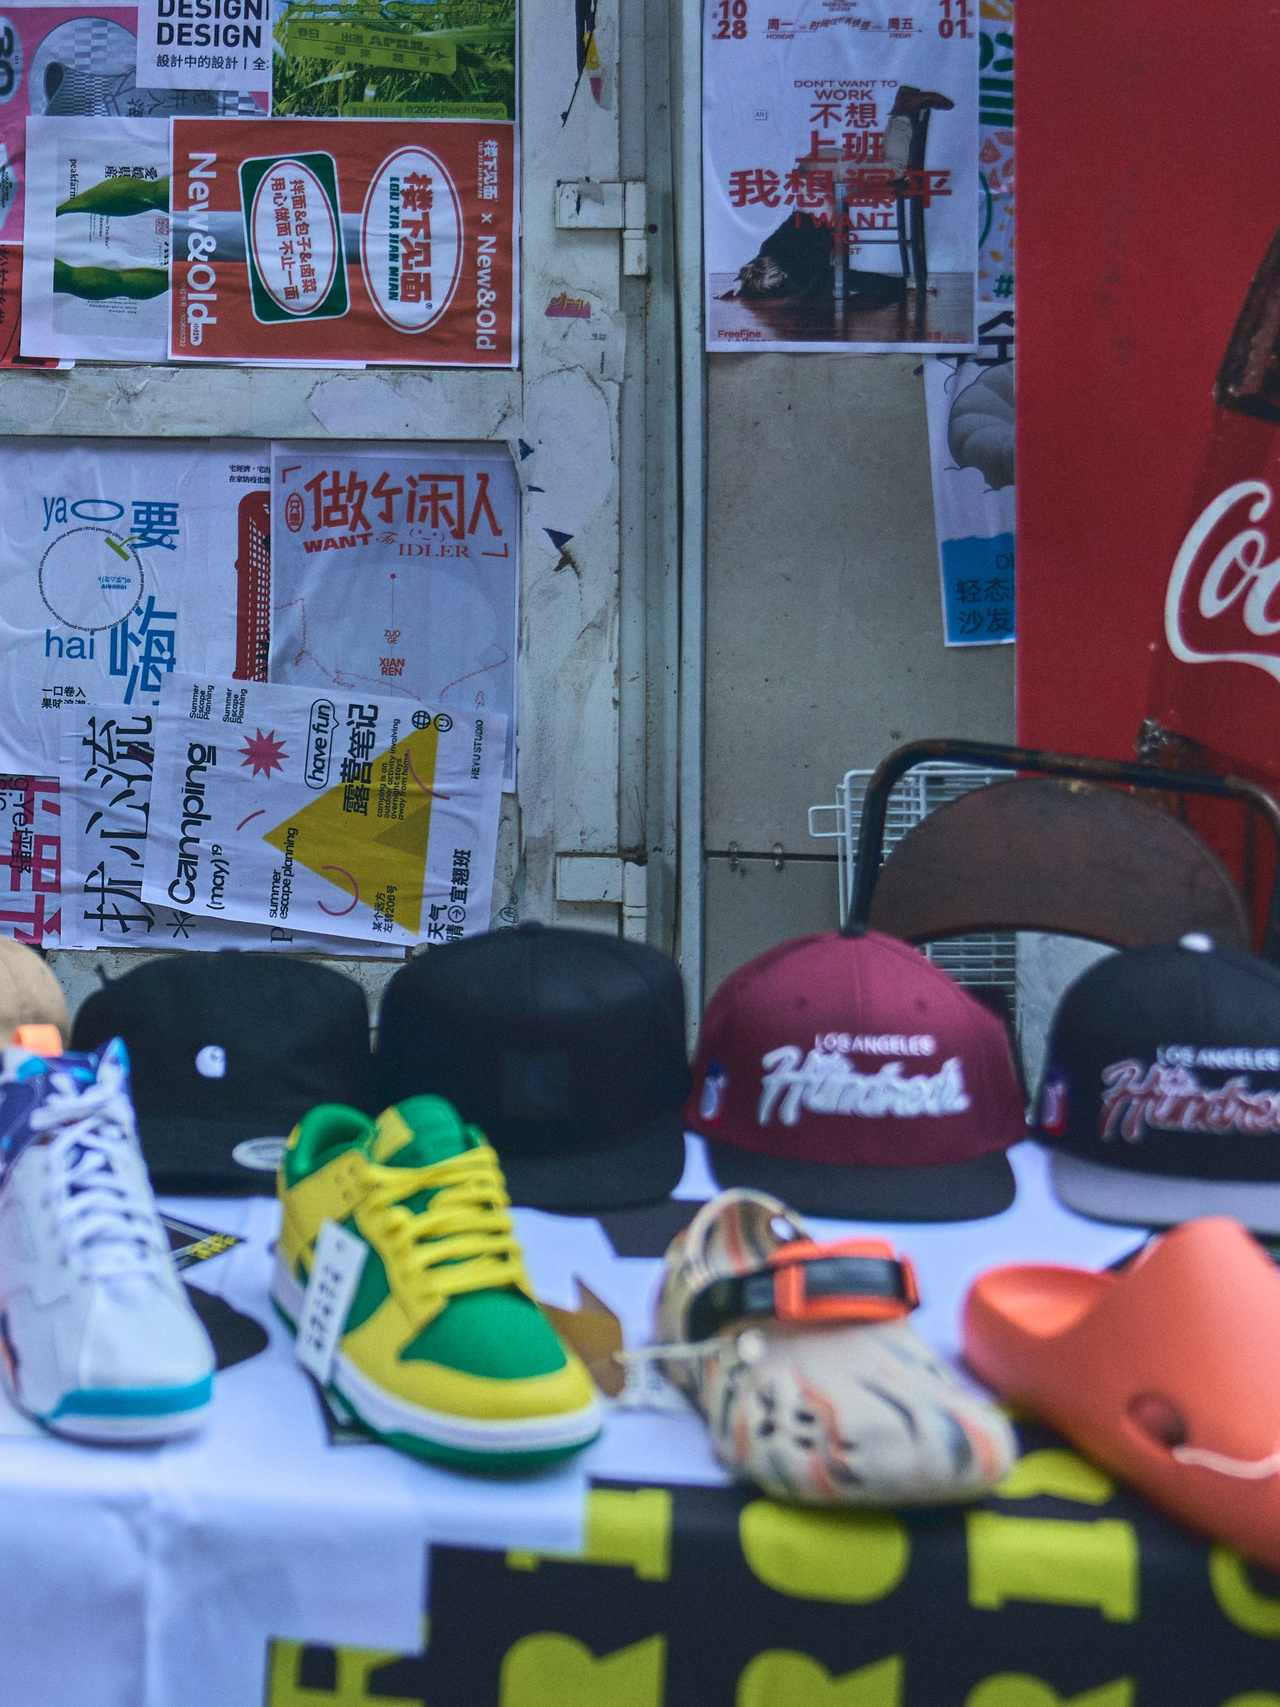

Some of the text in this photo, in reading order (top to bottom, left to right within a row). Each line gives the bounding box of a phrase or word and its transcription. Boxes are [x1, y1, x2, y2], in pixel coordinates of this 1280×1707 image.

[157, 22, 262, 48] DESIGN
[718, 20, 747, 39] 28
[888, 18, 914, 30] 周五
[938, 19, 968, 39] 01
[157, 54, 239, 69] 設計中的設計
[793, 80, 898, 88] DON'T WANT TO
[815, 90, 873, 100] WORK
[472, 107, 504, 116] Design
[810, 103, 878, 128] 不想
[795, 131, 886, 165] 上班
[68, 159, 80, 200] peakfarm
[400, 172, 433, 303] 楼下见面
[812, 212, 894, 229] WANT
[187, 153, 217, 325] New&Old
[271, 178, 299, 301] 用心做面 不止一面
[389, 177, 400, 300] LOU XIA JIAN MIAN
[476, 236, 496, 349] New&Old
[718, 330, 761, 339] FreeFine
[130, 501, 179, 551] 要
[303, 532, 373, 553] WANT
[398, 544, 470, 558] IDLER
[45, 629, 95, 660] hai
[379, 658, 405, 668] XIAN
[381, 667, 403, 676] REN
[189, 684, 198, 719] Summer
[204, 685, 214, 720] Planning
[223, 688, 232, 723] Summer
[237, 689, 248, 724] Planning
[308, 704, 331, 782] have fun
[340, 704, 379, 816] 露营笔记
[168, 743, 212, 905] Camping
[283, 828, 298, 876] planning
[270, 869, 281, 919] summer
[280, 877, 291, 919] escape
[428, 904, 447, 941] 天气
[815, 1032, 937, 1057] LOS ANGELES
